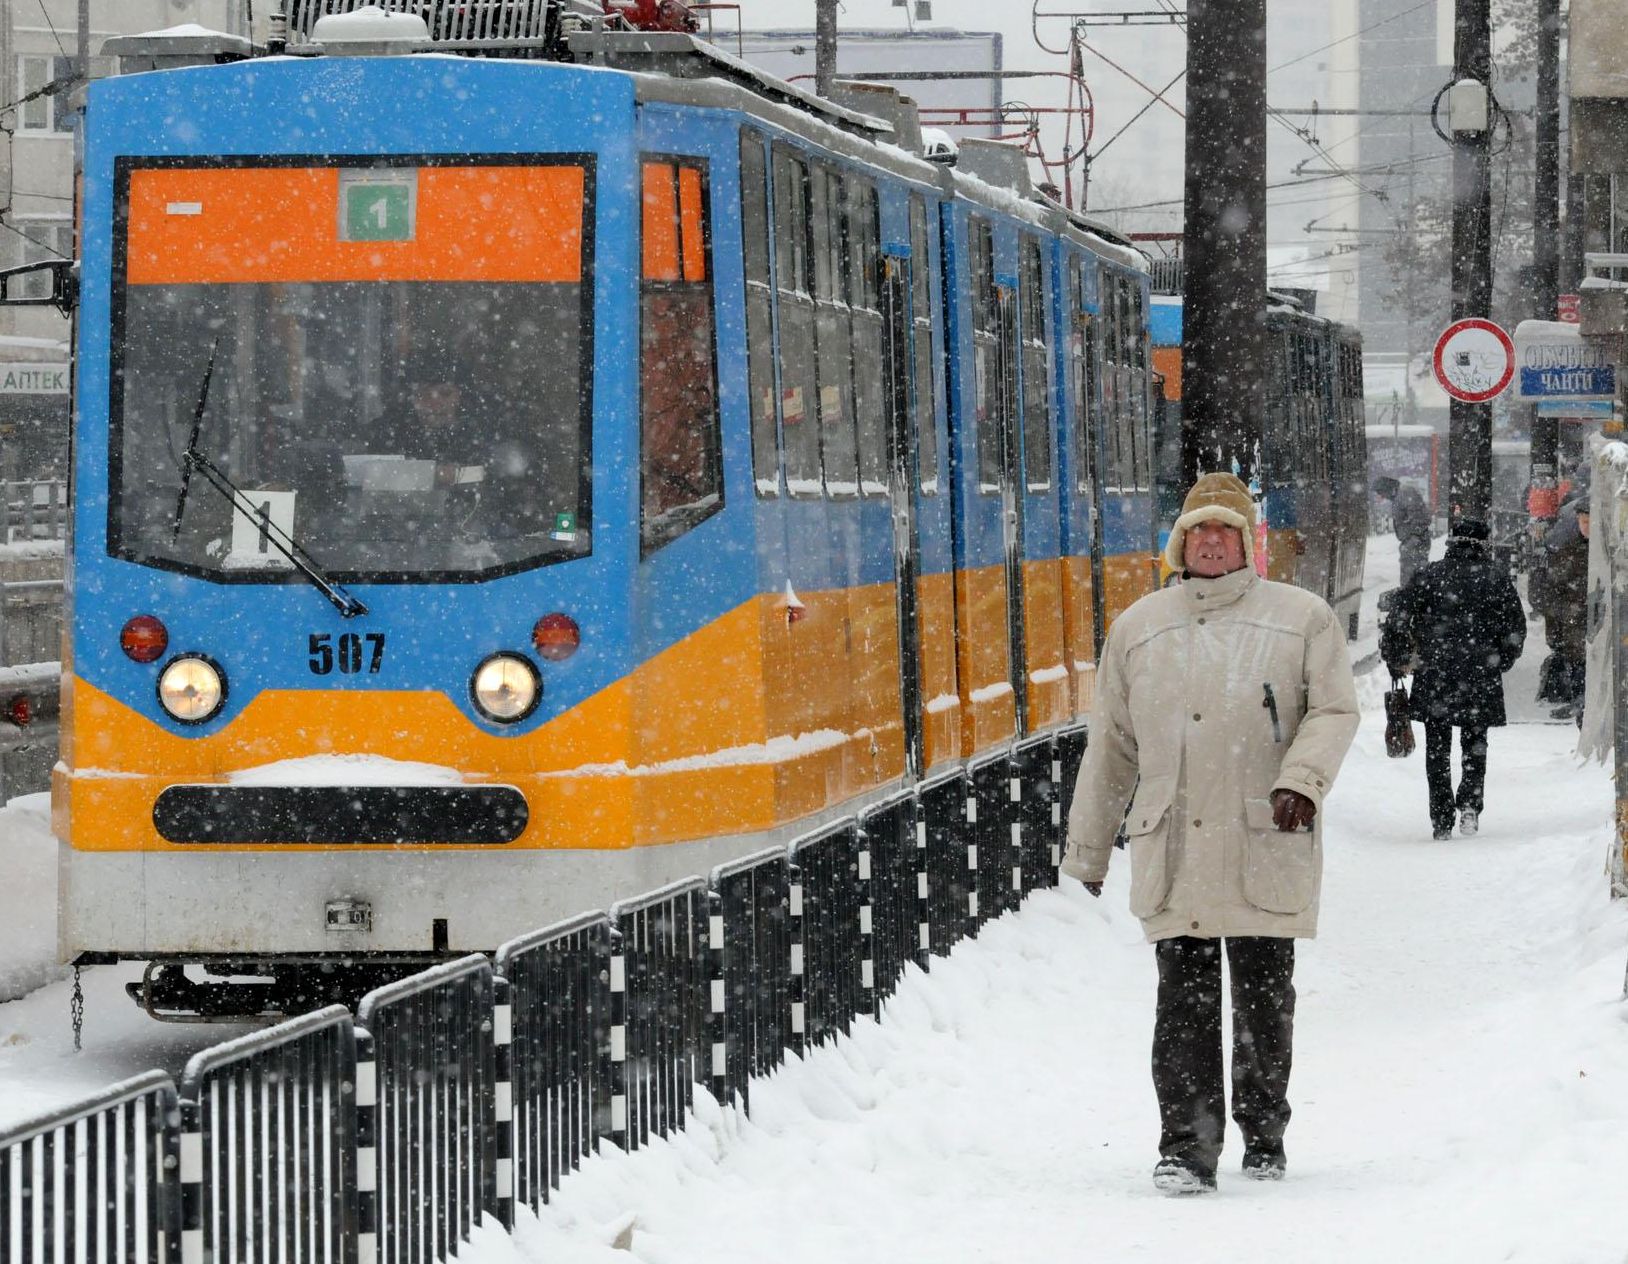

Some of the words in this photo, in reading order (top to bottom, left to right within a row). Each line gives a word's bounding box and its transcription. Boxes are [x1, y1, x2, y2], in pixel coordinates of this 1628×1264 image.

[369, 197, 387, 229] 1
[3, 371, 69, 389] АПТЕК
[1541, 372, 1593, 390] ЧАНТИ
[254, 501, 270, 554] 1
[309, 632, 385, 675] 507
